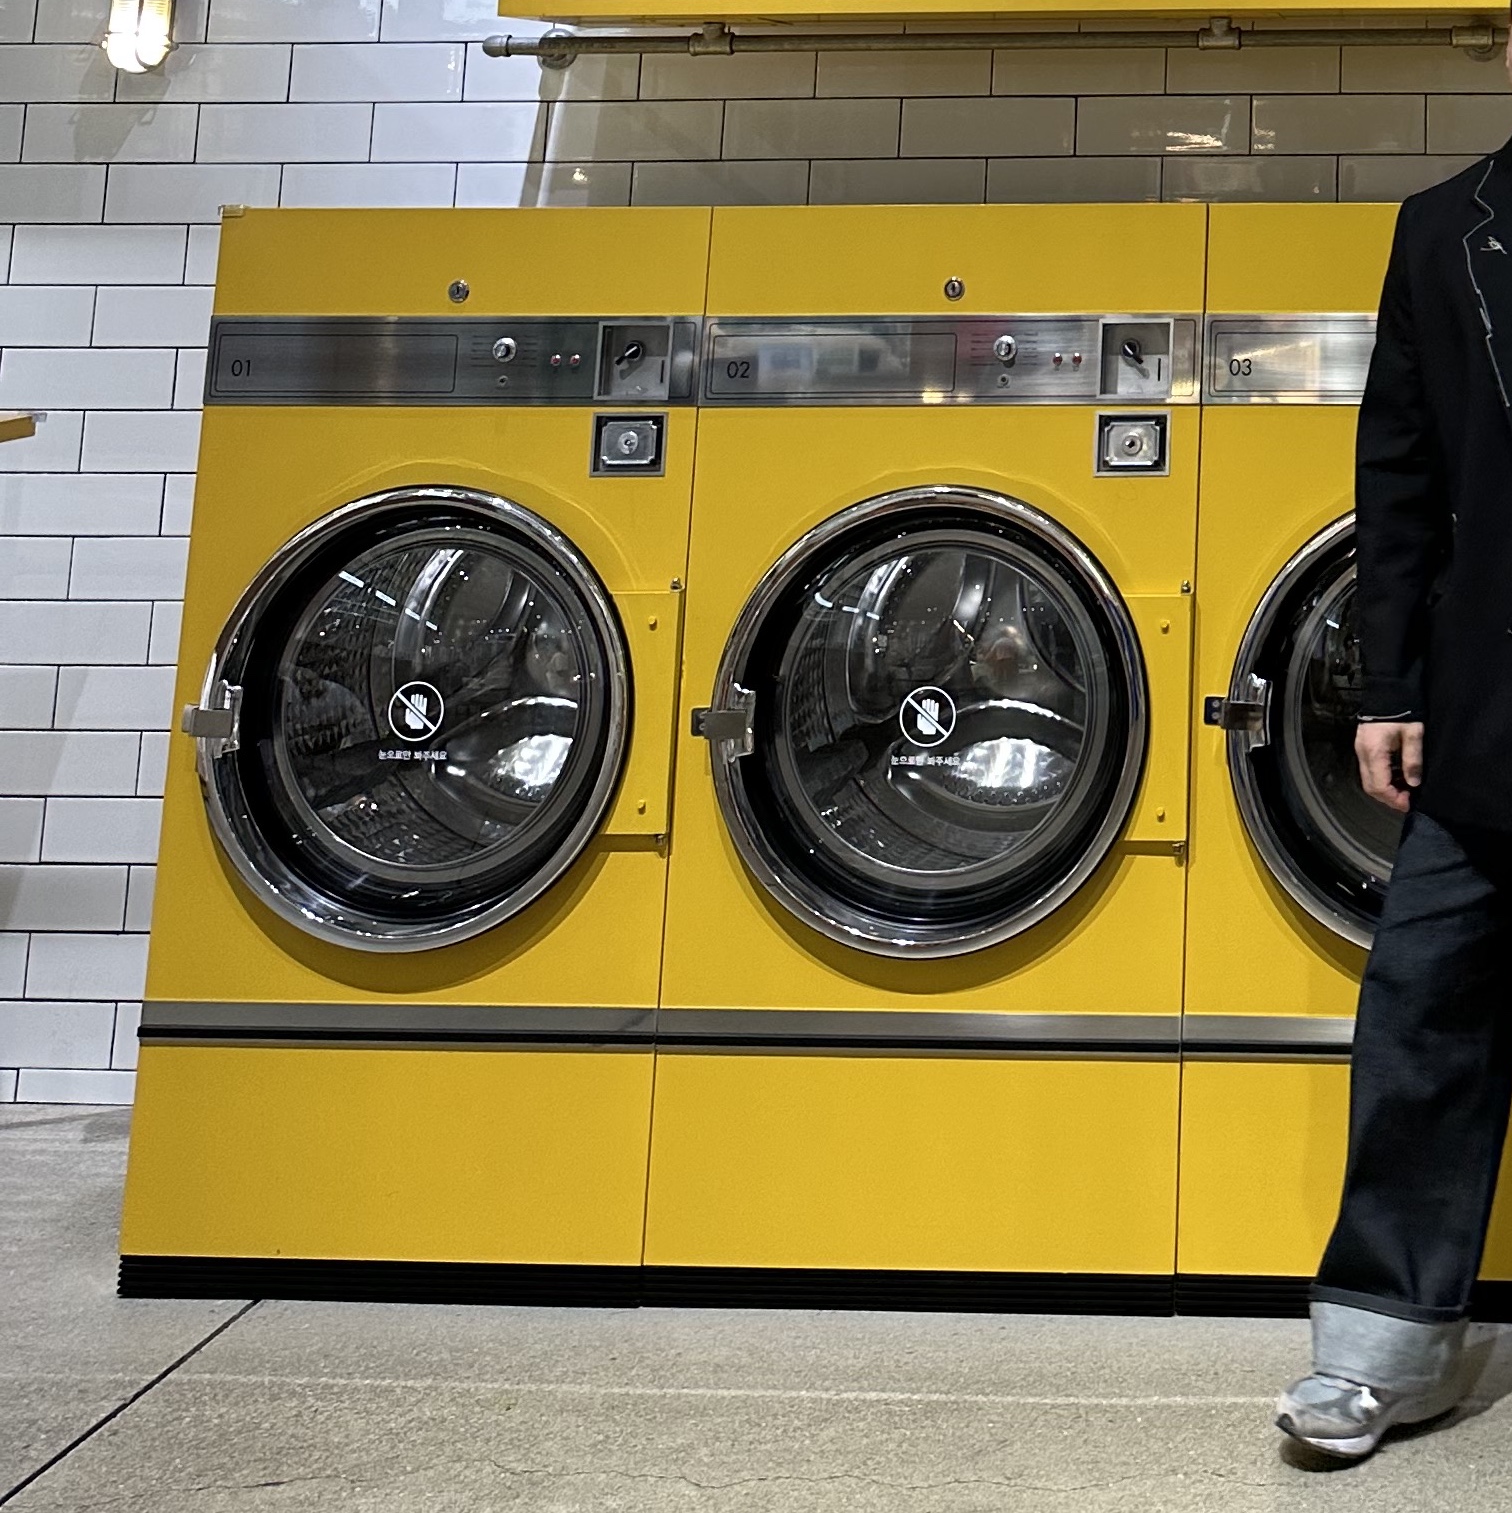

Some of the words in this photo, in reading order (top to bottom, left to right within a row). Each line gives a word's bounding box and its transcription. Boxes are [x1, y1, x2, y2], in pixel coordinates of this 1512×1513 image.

[230, 359, 252, 377] 01
[726, 360, 751, 380] 02
[1228, 358, 1253, 377] 03
